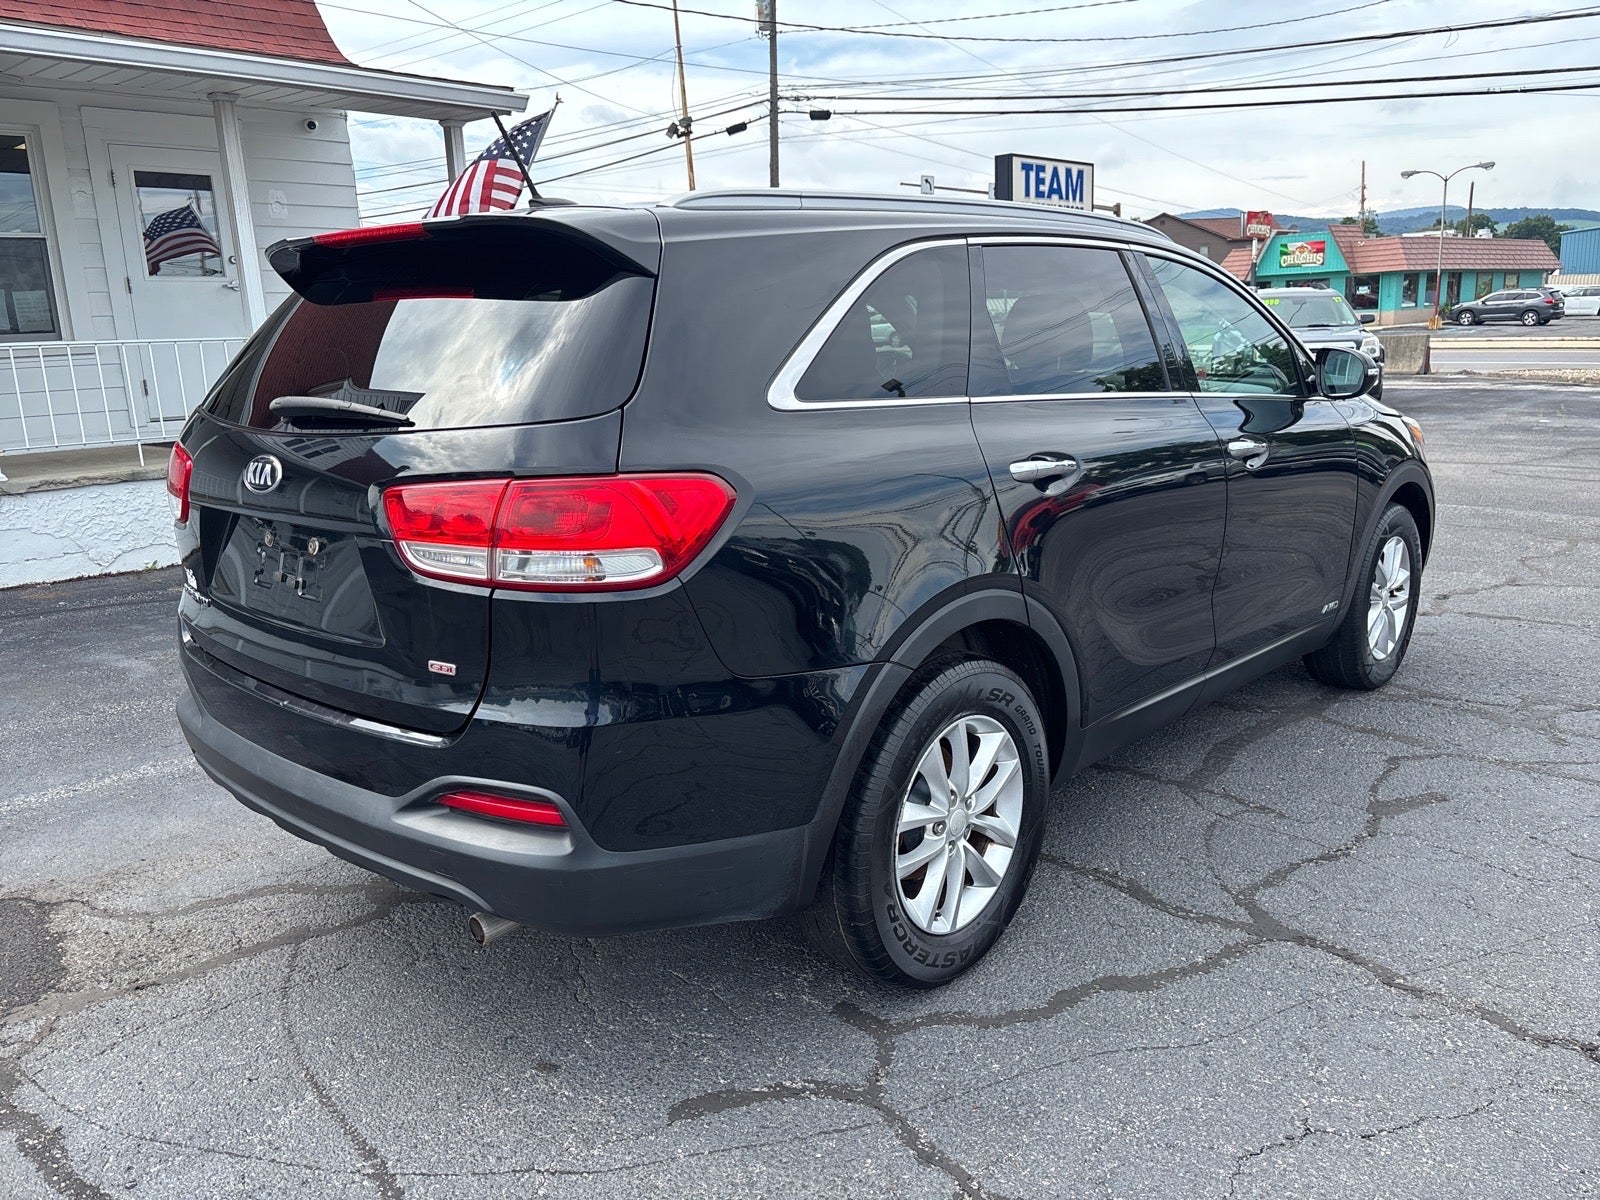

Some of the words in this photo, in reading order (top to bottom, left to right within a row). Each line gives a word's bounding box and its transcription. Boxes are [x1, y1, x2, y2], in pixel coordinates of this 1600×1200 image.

[1020, 162, 1085, 203] TEAM
[1280, 252, 1324, 268] CHUCHIS
[247, 462, 272, 486] KIA
[1014, 704, 1037, 736] GRAND
